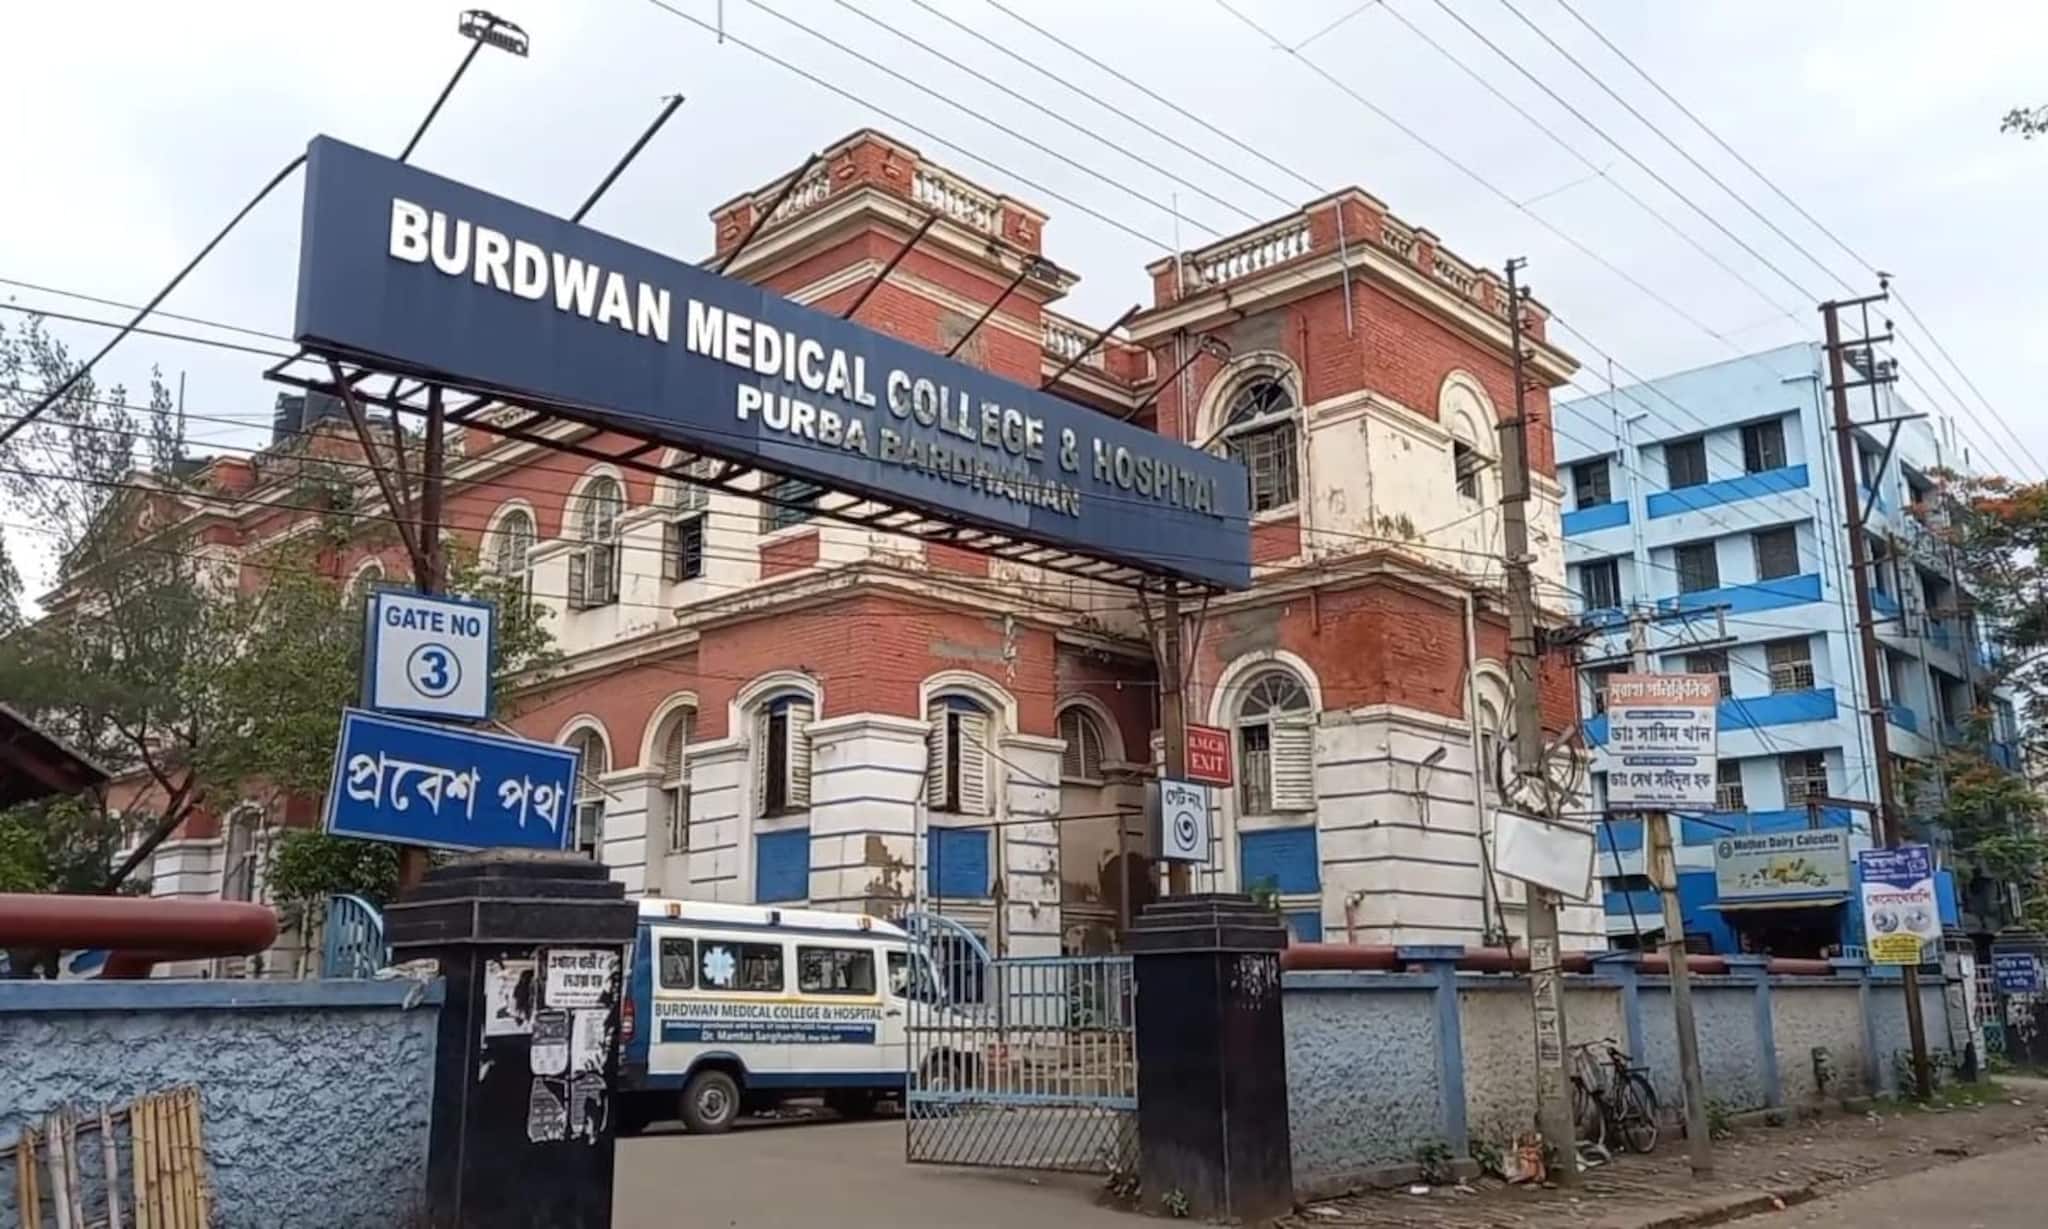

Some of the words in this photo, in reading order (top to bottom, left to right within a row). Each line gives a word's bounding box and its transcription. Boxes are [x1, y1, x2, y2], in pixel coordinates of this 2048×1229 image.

[389, 198, 671, 343] BURDWAN
[687, 299, 876, 407] MEDICAL
[888, 369, 1044, 462] COLLEGE
[1060, 427, 1080, 474] &
[1093, 437, 1223, 521] HOSPITAL
[737, 384, 869, 456] PURBA
[880, 427, 1080, 518] BARDHAMAN
[385, 605, 444, 633] GATE
[450, 614, 480, 637] NO
[420, 651, 448, 690] 3
[1190, 752, 1225, 772] EXIT
[347, 750, 481, 821] প্রবেশ
[498, 775, 565, 833] পথ
[1734, 839, 1766, 850] Mother
[1769, 836, 1794, 849] Dairy
[1796, 832, 1839, 846] Calcutta
[655, 1002, 718, 1017] BURDWAN
[721, 1003, 772, 1019] MEDICAL
[774, 1004, 821, 1020] COLLEGE
[823, 1006, 831, 1020] &
[834, 1006, 882, 1021] HOSPITAL
